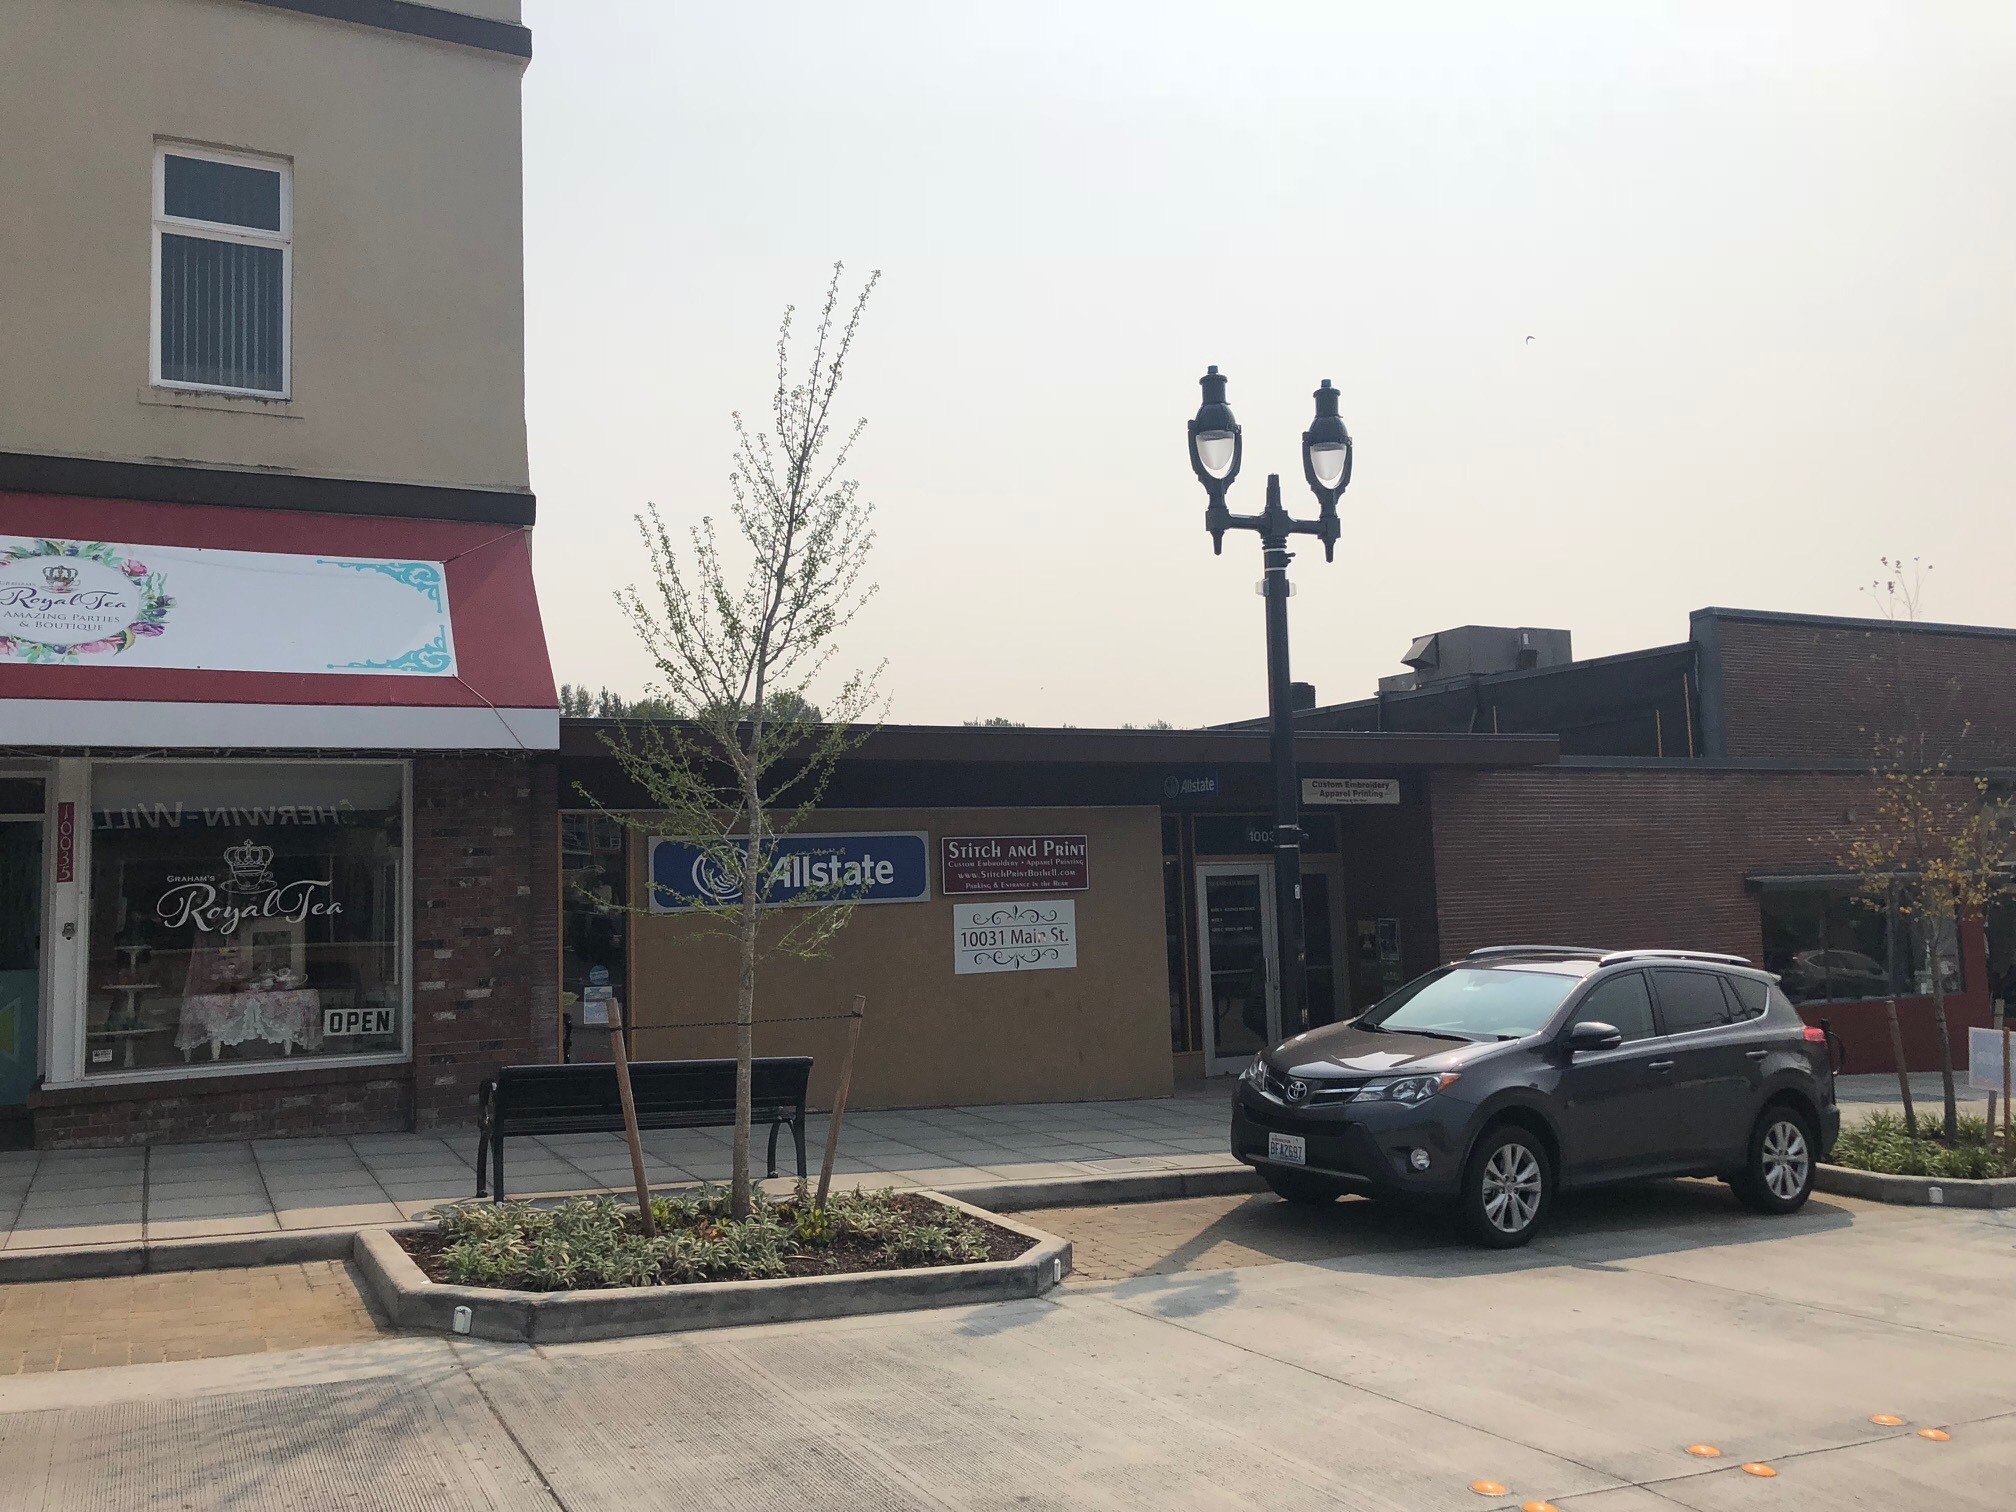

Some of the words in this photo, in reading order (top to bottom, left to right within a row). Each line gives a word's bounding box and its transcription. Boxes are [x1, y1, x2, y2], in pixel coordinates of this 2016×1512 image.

[0, 586, 82, 611] Royal
[80, 590, 127, 610] Tea
[3, 611, 67, 620] AMAZING
[72, 613, 120, 623] PARTIES
[35, 621, 104, 631] BOUTIQUE
[1180, 777, 1215, 793] Allstate
[1320, 790, 1350, 798] Apparel
[1353, 790, 1383, 798] Printing
[1345, 781, 1389, 790] Embroidery
[764, 854, 894, 888] Allstate
[157, 883, 280, 935] Royal
[277, 880, 344, 923] Tea
[961, 930, 1004, 947] 10031
[1011, 928, 1046, 944] Main
[1050, 927, 1069, 942] St.
[329, 1011, 389, 1033] OPEN
